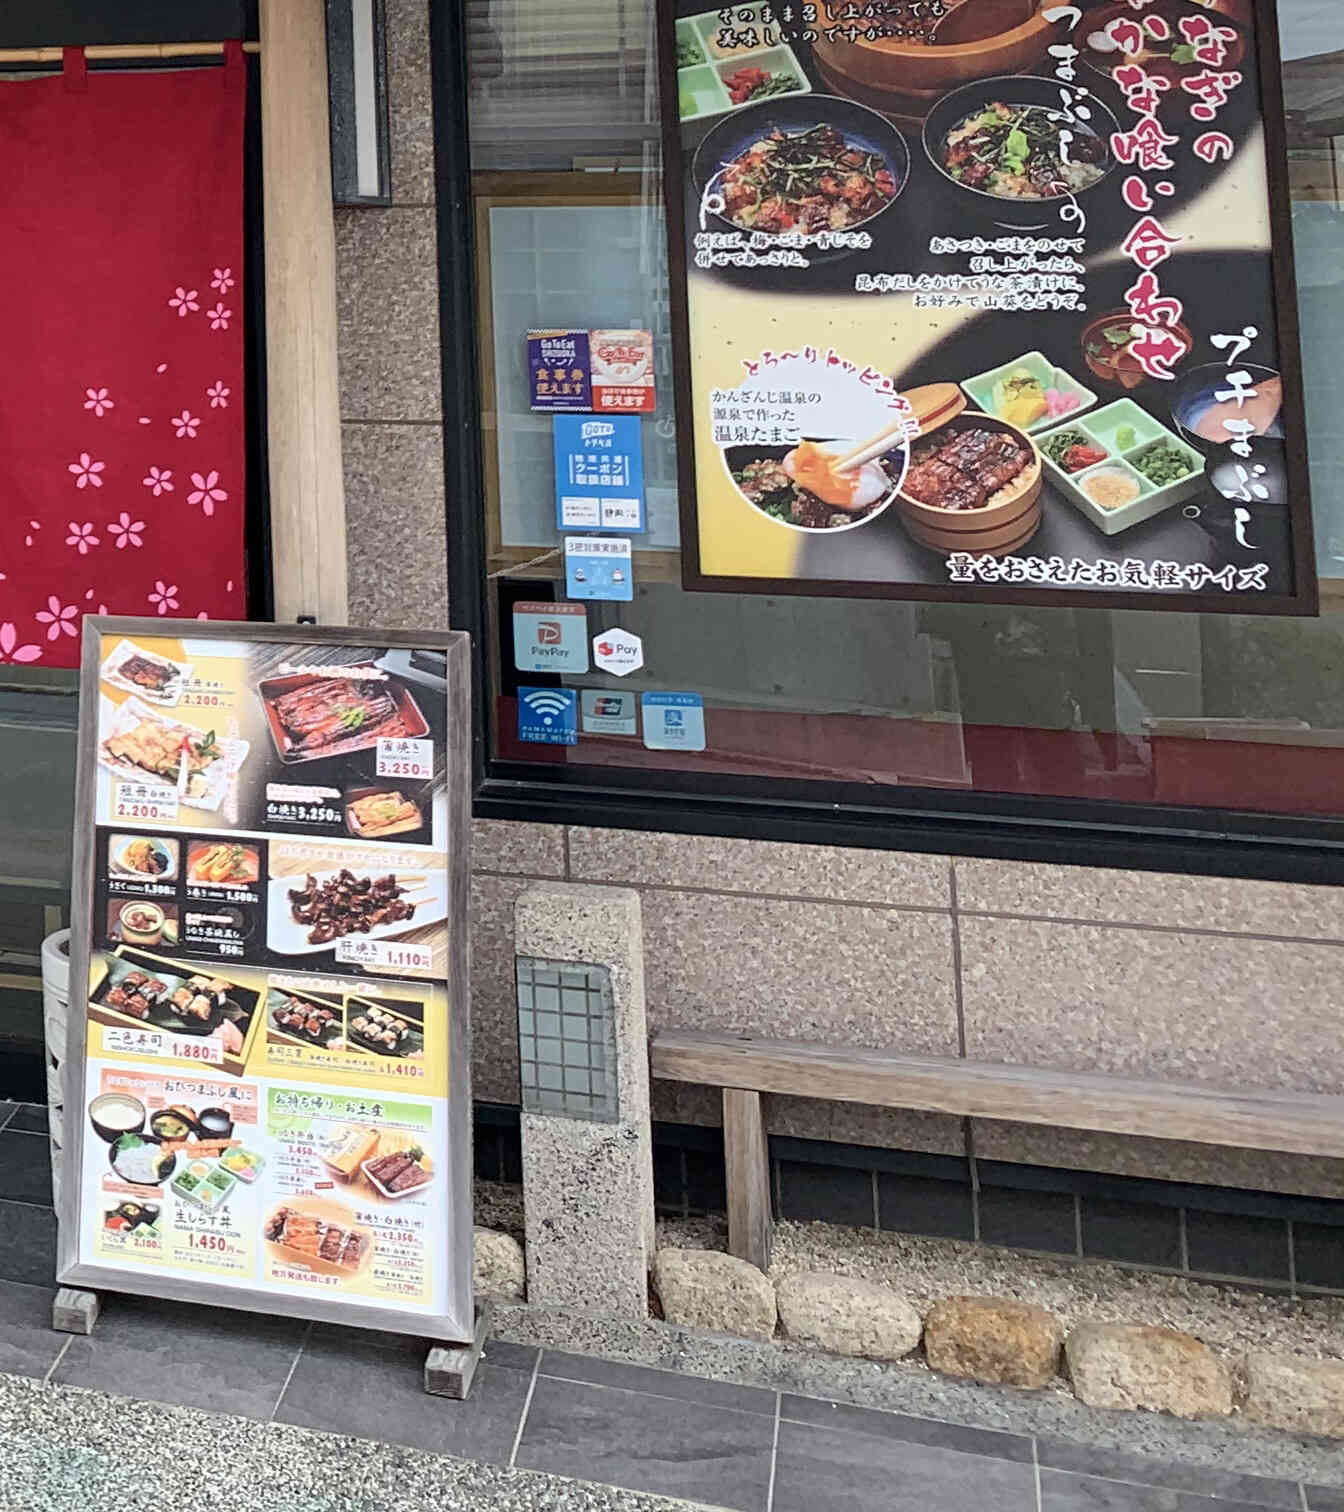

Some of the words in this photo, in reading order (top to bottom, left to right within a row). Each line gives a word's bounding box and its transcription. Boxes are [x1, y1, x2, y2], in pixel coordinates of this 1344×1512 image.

[719, 1, 948, 26] そのまま召し上がっても
[601, 395, 645, 408] 使えます
[712, 391, 822, 405] かんざんじ温泉の
[714, 408, 796, 422] 源泉で作った
[715, 425, 801, 442] 温泉たまご
[1210, 325, 1270, 550] プチまぶし
[575, 463, 623, 474] クーポン
[946, 551, 1269, 591] 量をおさえたお気軽サイズ
[531, 646, 570, 657] PayPay
[616, 643, 638, 656] Pay
